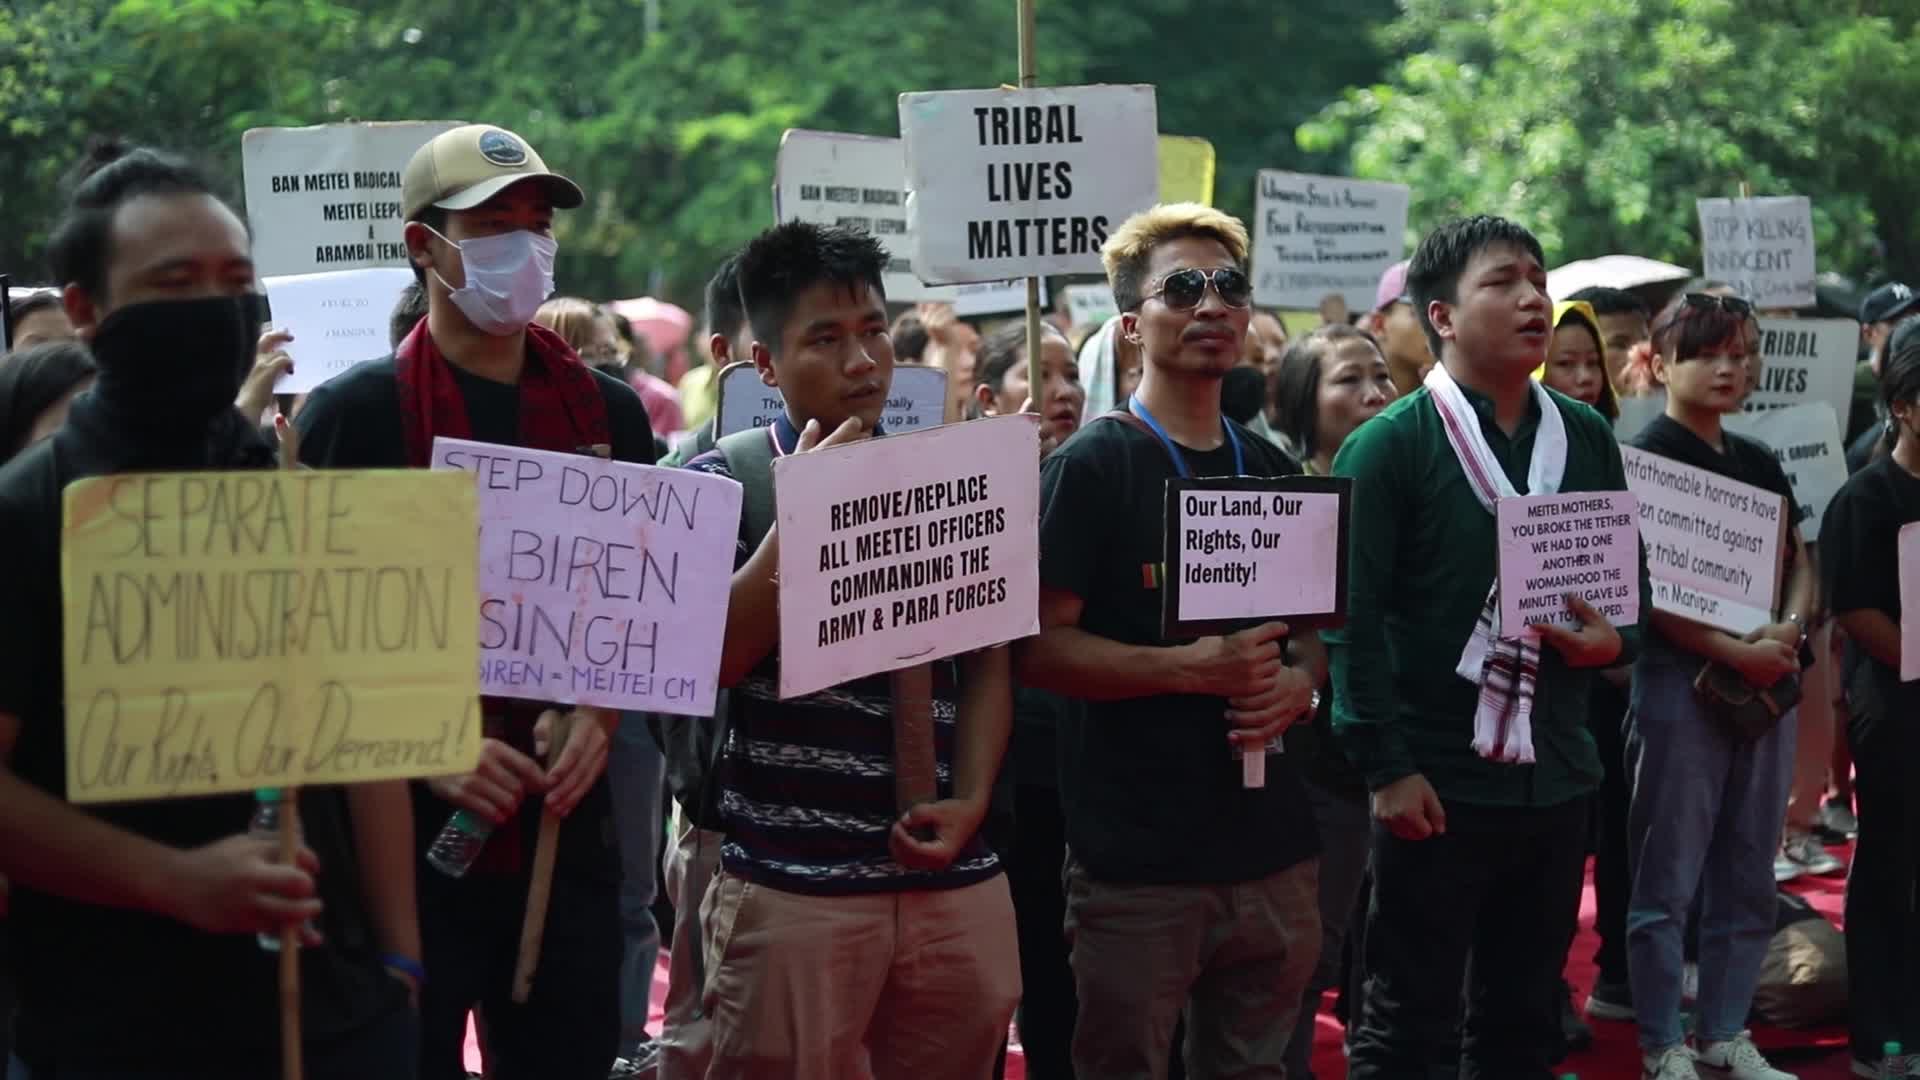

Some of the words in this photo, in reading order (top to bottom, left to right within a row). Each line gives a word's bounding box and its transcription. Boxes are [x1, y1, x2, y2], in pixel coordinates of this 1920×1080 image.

[973, 105, 1083, 146] TRIBAL
[272, 175, 300, 193] BAN
[304, 172, 350, 191] MEITEI
[987, 160, 1073, 203] LIVES
[323, 202, 368, 221] MEITEI
[316, 243, 375, 263] ARAMBAI
[967, 215, 1109, 261] MATTERS
[1755, 366, 1809, 393] IVES
[888, 416, 904, 427] up
[111, 473, 357, 558] SEPARATE
[559, 466, 701, 530] DOWN
[830, 474, 988, 532] REMOVE/REPLACE
[1185, 496, 1217, 516] Our
[1221, 496, 1268, 520] Land,
[1272, 495, 1303, 516] Our
[1527, 504, 1560, 518] MEITEI
[1704, 477, 1749, 512] horrors
[1751, 494, 1778, 521] have
[819, 540, 850, 572] ALL
[856, 524, 921, 563] MEETEI
[928, 507, 1006, 549] OFFICERS
[1185, 529, 1247, 554] Rights,
[1251, 528, 1281, 549] Our
[1511, 524, 1535, 539] YOU
[1537, 520, 1573, 535] BROKE
[1574, 519, 1593, 531] THE
[1595, 514, 1631, 529] TETHER
[1531, 541, 1549, 554] WE
[1550, 538, 1573, 552] HAD
[1575, 536, 1590, 549] TO
[1591, 534, 1613, 547] ONE
[1657, 507, 1721, 541] committed
[1722, 528, 1764, 554] against
[507, 529, 680, 604] BIREN
[830, 555, 954, 606] COMMANDING
[960, 546, 990, 577] THE
[1185, 562, 1257, 587] Identity!
[1525, 571, 1602, 591] WOMANHOOD
[1602, 568, 1621, 581] THE
[1542, 553, 1591, 571] ANOTHER
[1593, 553, 1605, 564] IN
[1656, 542, 1690, 569] tribal
[1691, 555, 1752, 595] community
[1518, 594, 1558, 610] MINUTE
[1560, 590, 1584, 605] YU
[1585, 587, 1613, 602] GAVE
[1615, 585, 1629, 597] US
[1657, 583, 1669, 599] in
[81, 566, 453, 666] ADMINISTRATION
[818, 609, 867, 648] ARMY
[872, 607, 885, 631] &
[892, 593, 940, 628] PARA
[946, 577, 1007, 616] FORCES
[479, 598, 658, 674] SINGH
[571, 664, 655, 696] MEITEI
[663, 676, 697, 702] CM
[77, 688, 143, 791] Our
[233, 681, 304, 780] Our
[302, 680, 472, 775] Demand!
